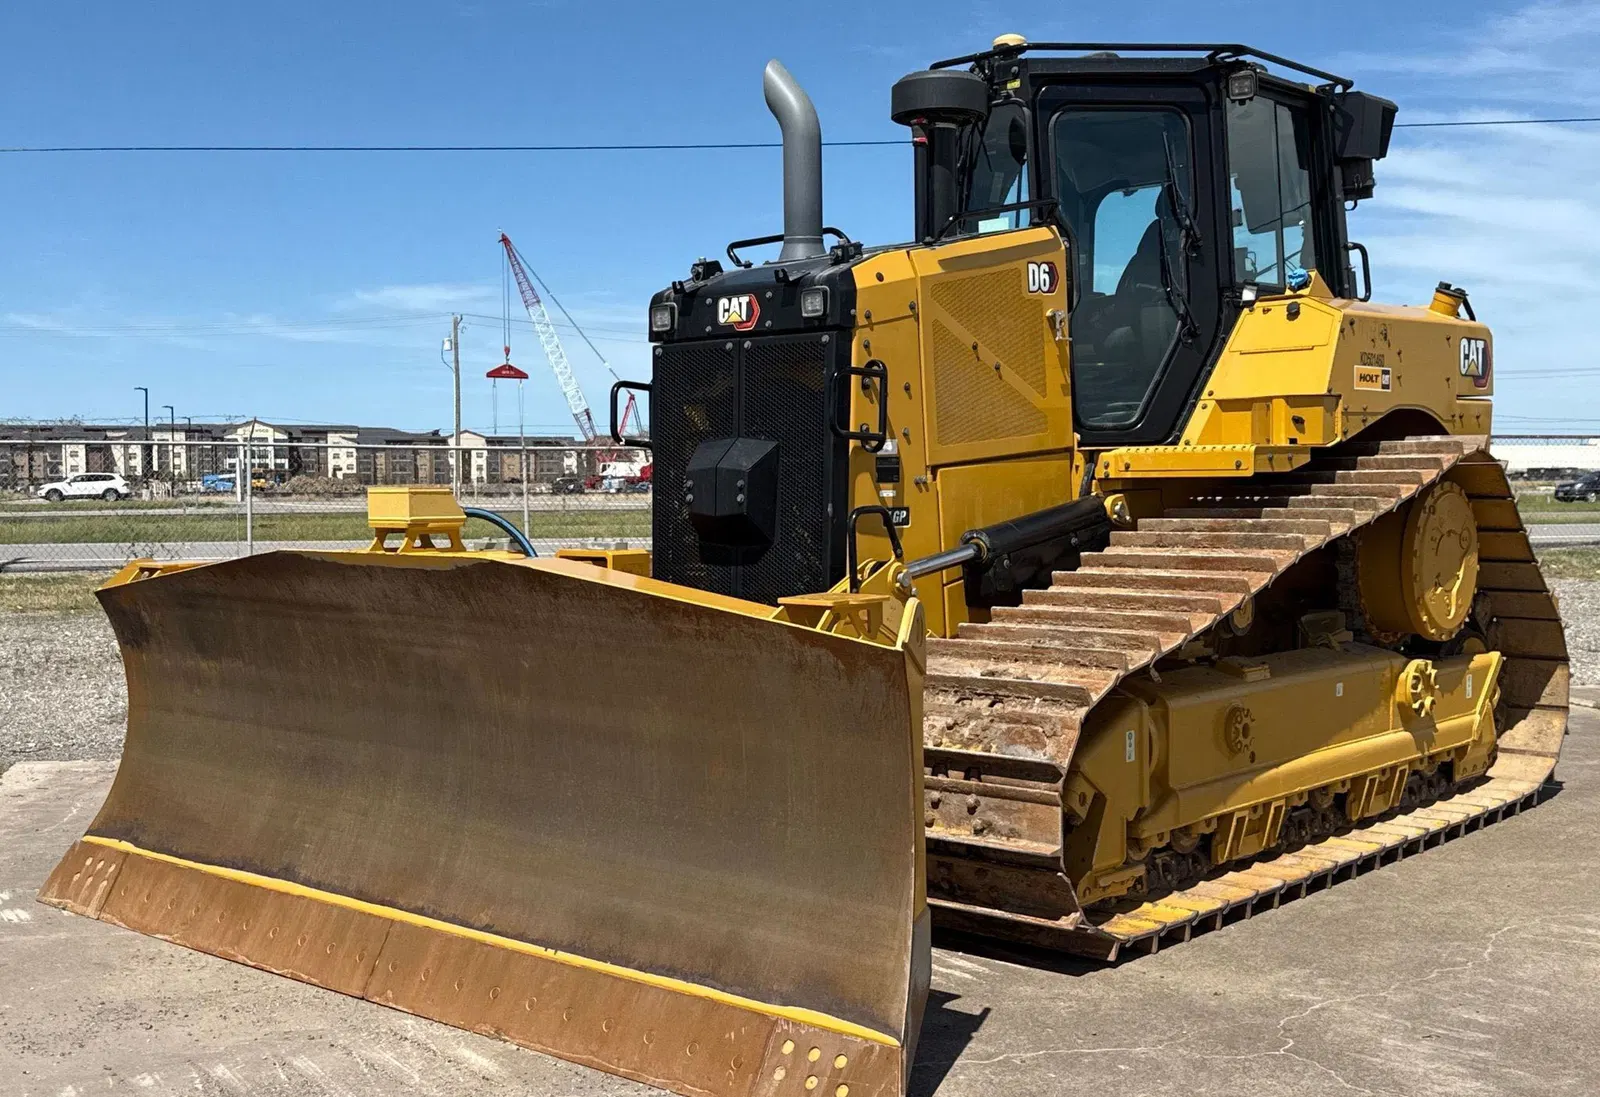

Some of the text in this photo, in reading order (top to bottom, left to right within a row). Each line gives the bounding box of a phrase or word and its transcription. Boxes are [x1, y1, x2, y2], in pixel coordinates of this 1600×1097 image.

[1027, 262, 1050, 292] D6
[718, 296, 750, 324] CAT
[1460, 337, 1485, 377] CAT
[1359, 373, 1380, 384] HOLT
[888, 509, 907, 523] GP
